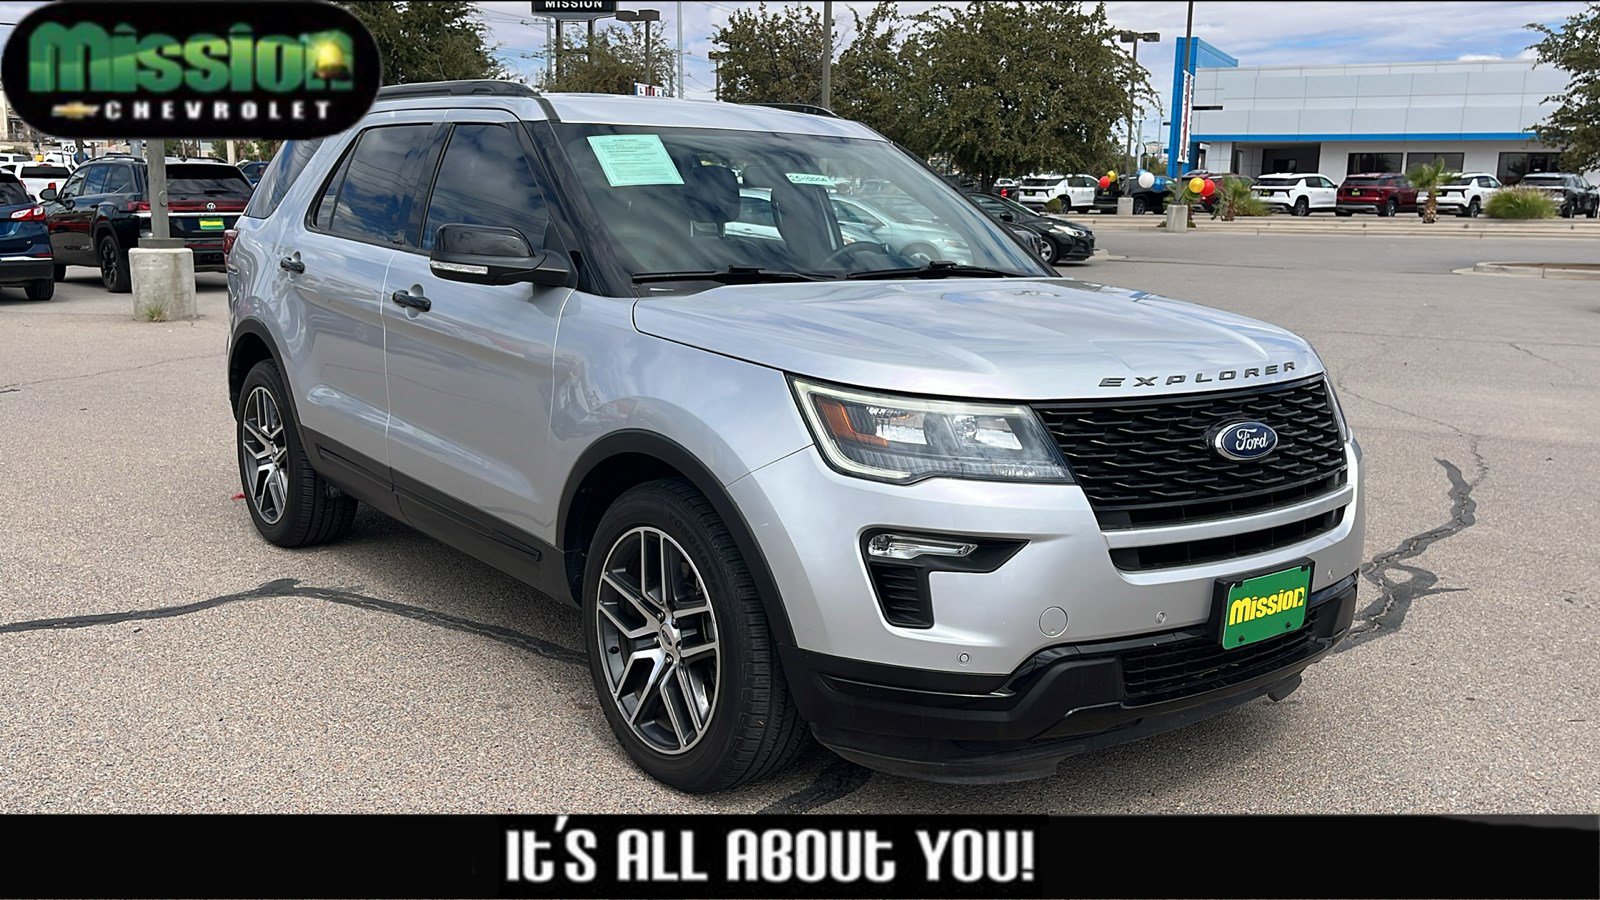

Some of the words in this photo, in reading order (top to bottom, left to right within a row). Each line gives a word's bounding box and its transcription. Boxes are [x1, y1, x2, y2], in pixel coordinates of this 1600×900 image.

[545, 0, 603, 8] MISSION
[63, 145, 76, 153] 40
[1099, 361, 1296, 387] EXPLORER
[1236, 428, 1268, 450] Ford
[1229, 586, 1305, 626] Mission
